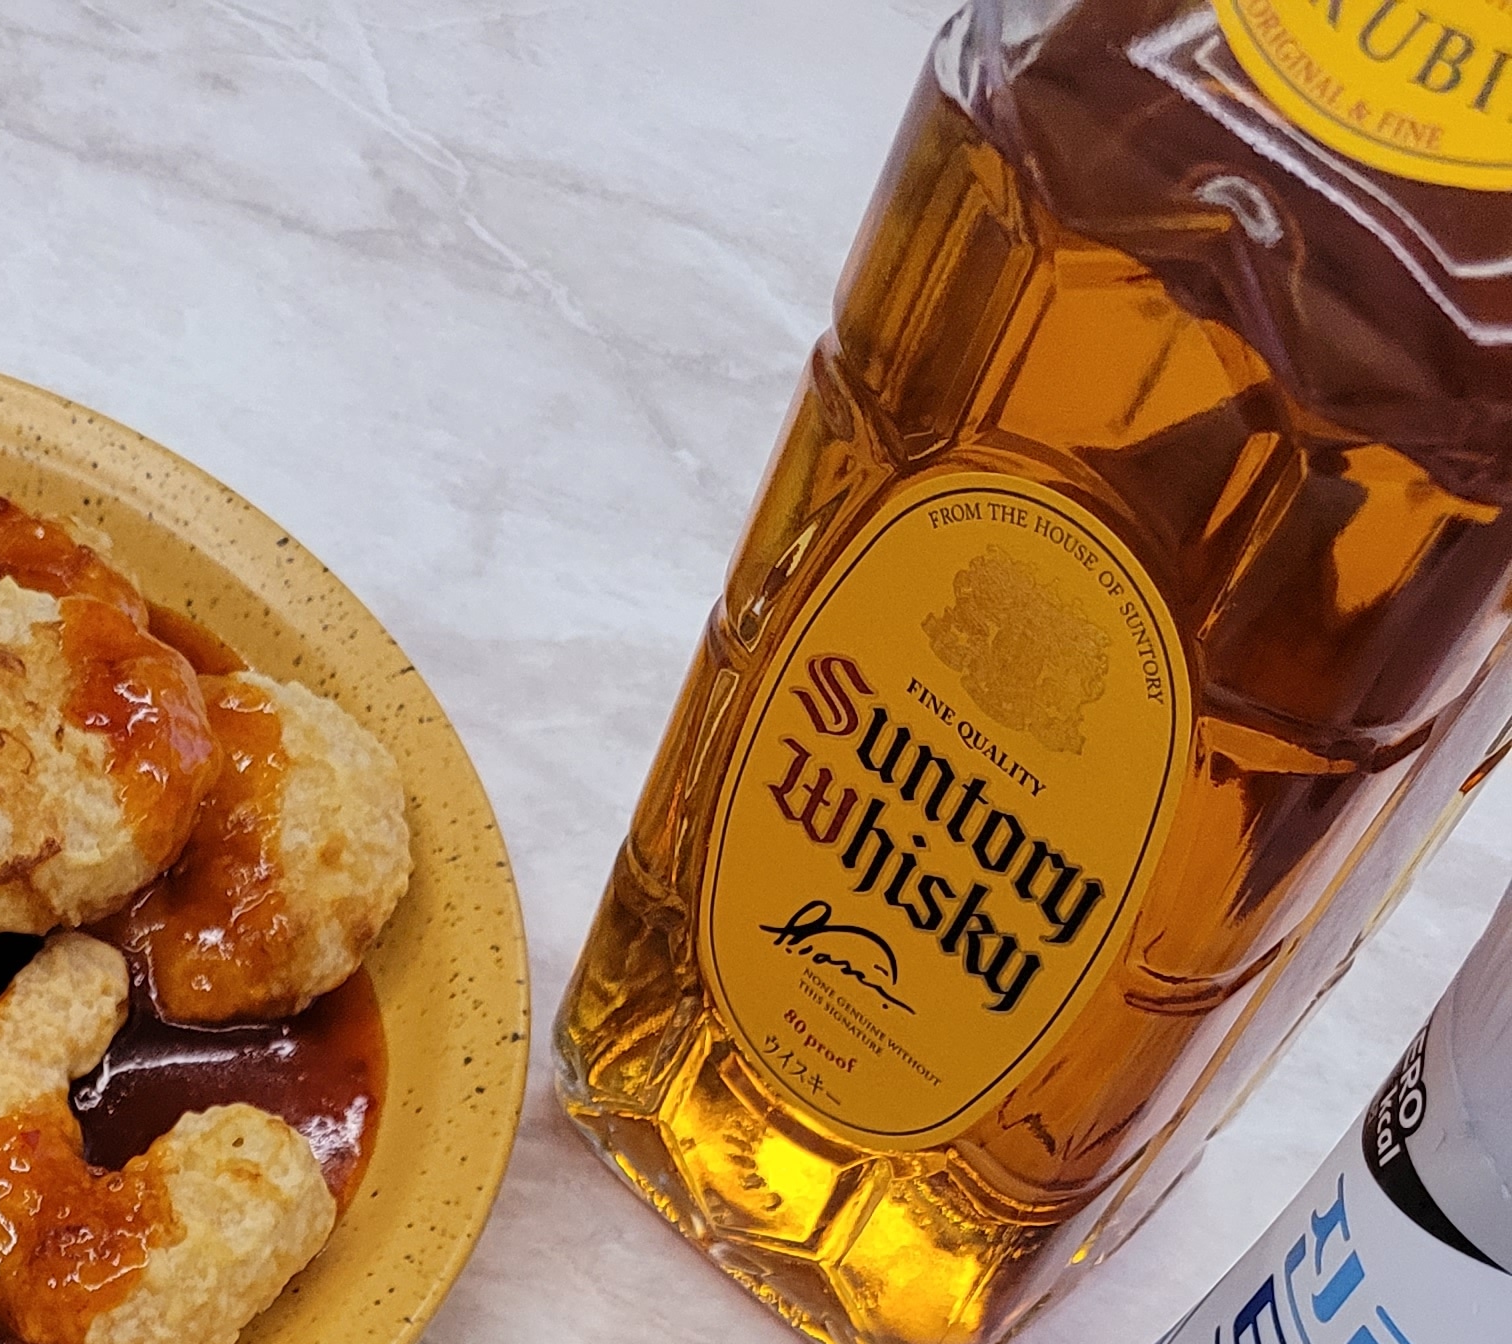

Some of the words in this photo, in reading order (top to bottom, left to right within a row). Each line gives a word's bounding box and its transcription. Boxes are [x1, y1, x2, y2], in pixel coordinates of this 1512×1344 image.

[1245, 0, 1345, 107] ORIGINAL
[1348, 99, 1370, 122] &
[1377, 109, 1444, 151] FINE
[1308, 0, 1512, 124] UBI
[928, 502, 982, 529] FROM
[987, 502, 1029, 528] THE
[1033, 516, 1099, 571] HOUSE
[1098, 570, 1125, 598] OF
[1119, 601, 1164, 705] SUNTORY
[905, 676, 958, 726] FINE
[957, 720, 1047, 799] QUALITY
[790, 656, 1106, 945] Suntory
[767, 736, 1044, 1014] Whisky
[763, 1034, 841, 1106] ウイスキー
[783, 1008, 807, 1035] 80
[803, 1033, 858, 1073] proof
[798, 978, 823, 1006] THIS
[823, 1002, 884, 1058] SIGNATURE
[803, 967, 836, 998] NONE
[836, 996, 887, 1042] GENUINE
[887, 1037, 942, 1087] WITHOUT
[1398, 1026, 1428, 1130] ERO
